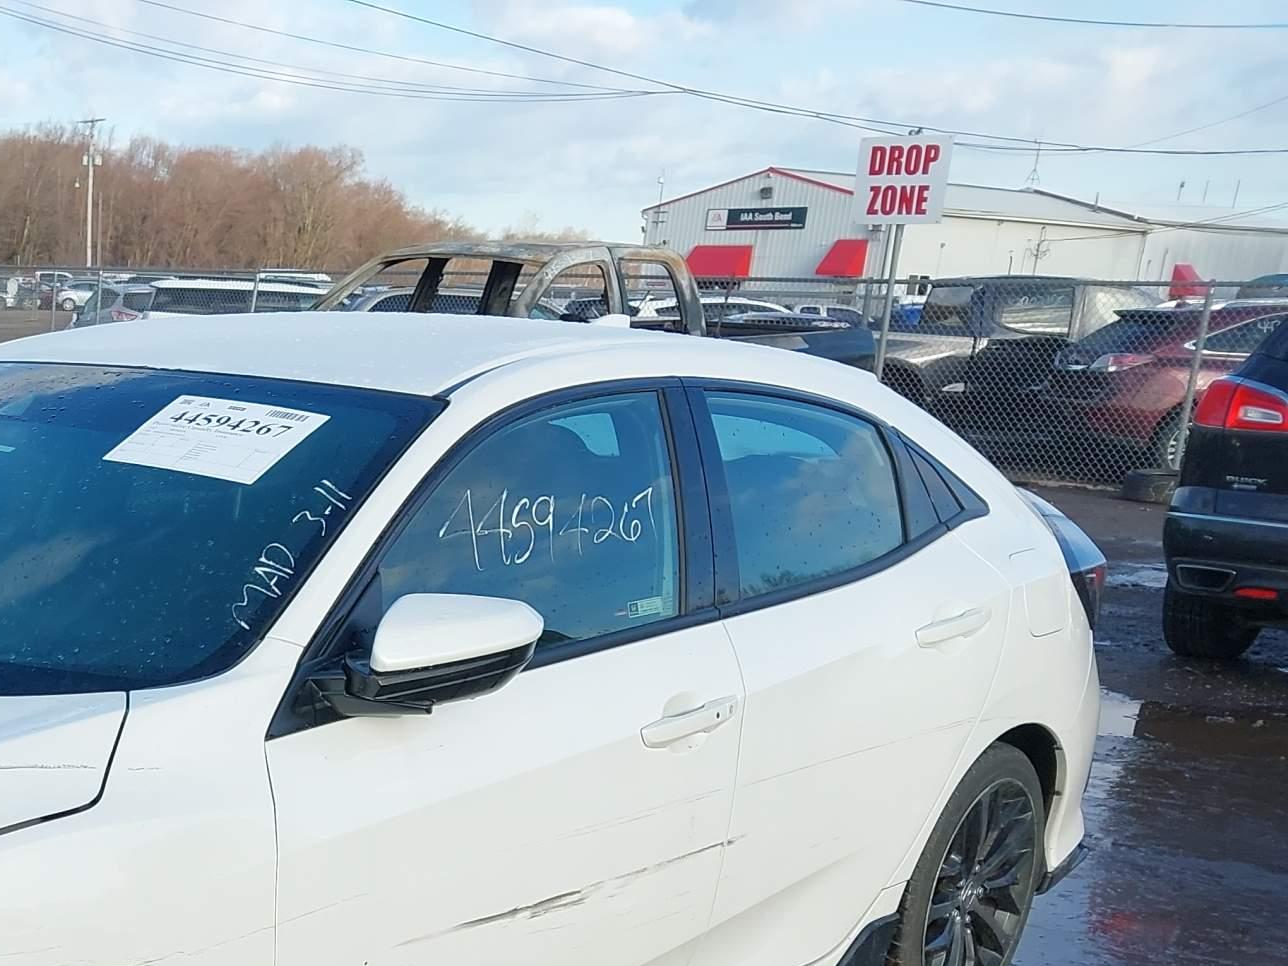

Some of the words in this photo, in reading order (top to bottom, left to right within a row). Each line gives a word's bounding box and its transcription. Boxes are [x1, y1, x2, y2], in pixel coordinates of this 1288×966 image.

[869, 144, 940, 176] DROP
[866, 185, 930, 216] ZONE
[169, 410, 294, 437] 44594267
[438, 487, 658, 571] 44594267
[231, 542, 295, 630] MAD
[292, 479, 353, 537] 3-11
